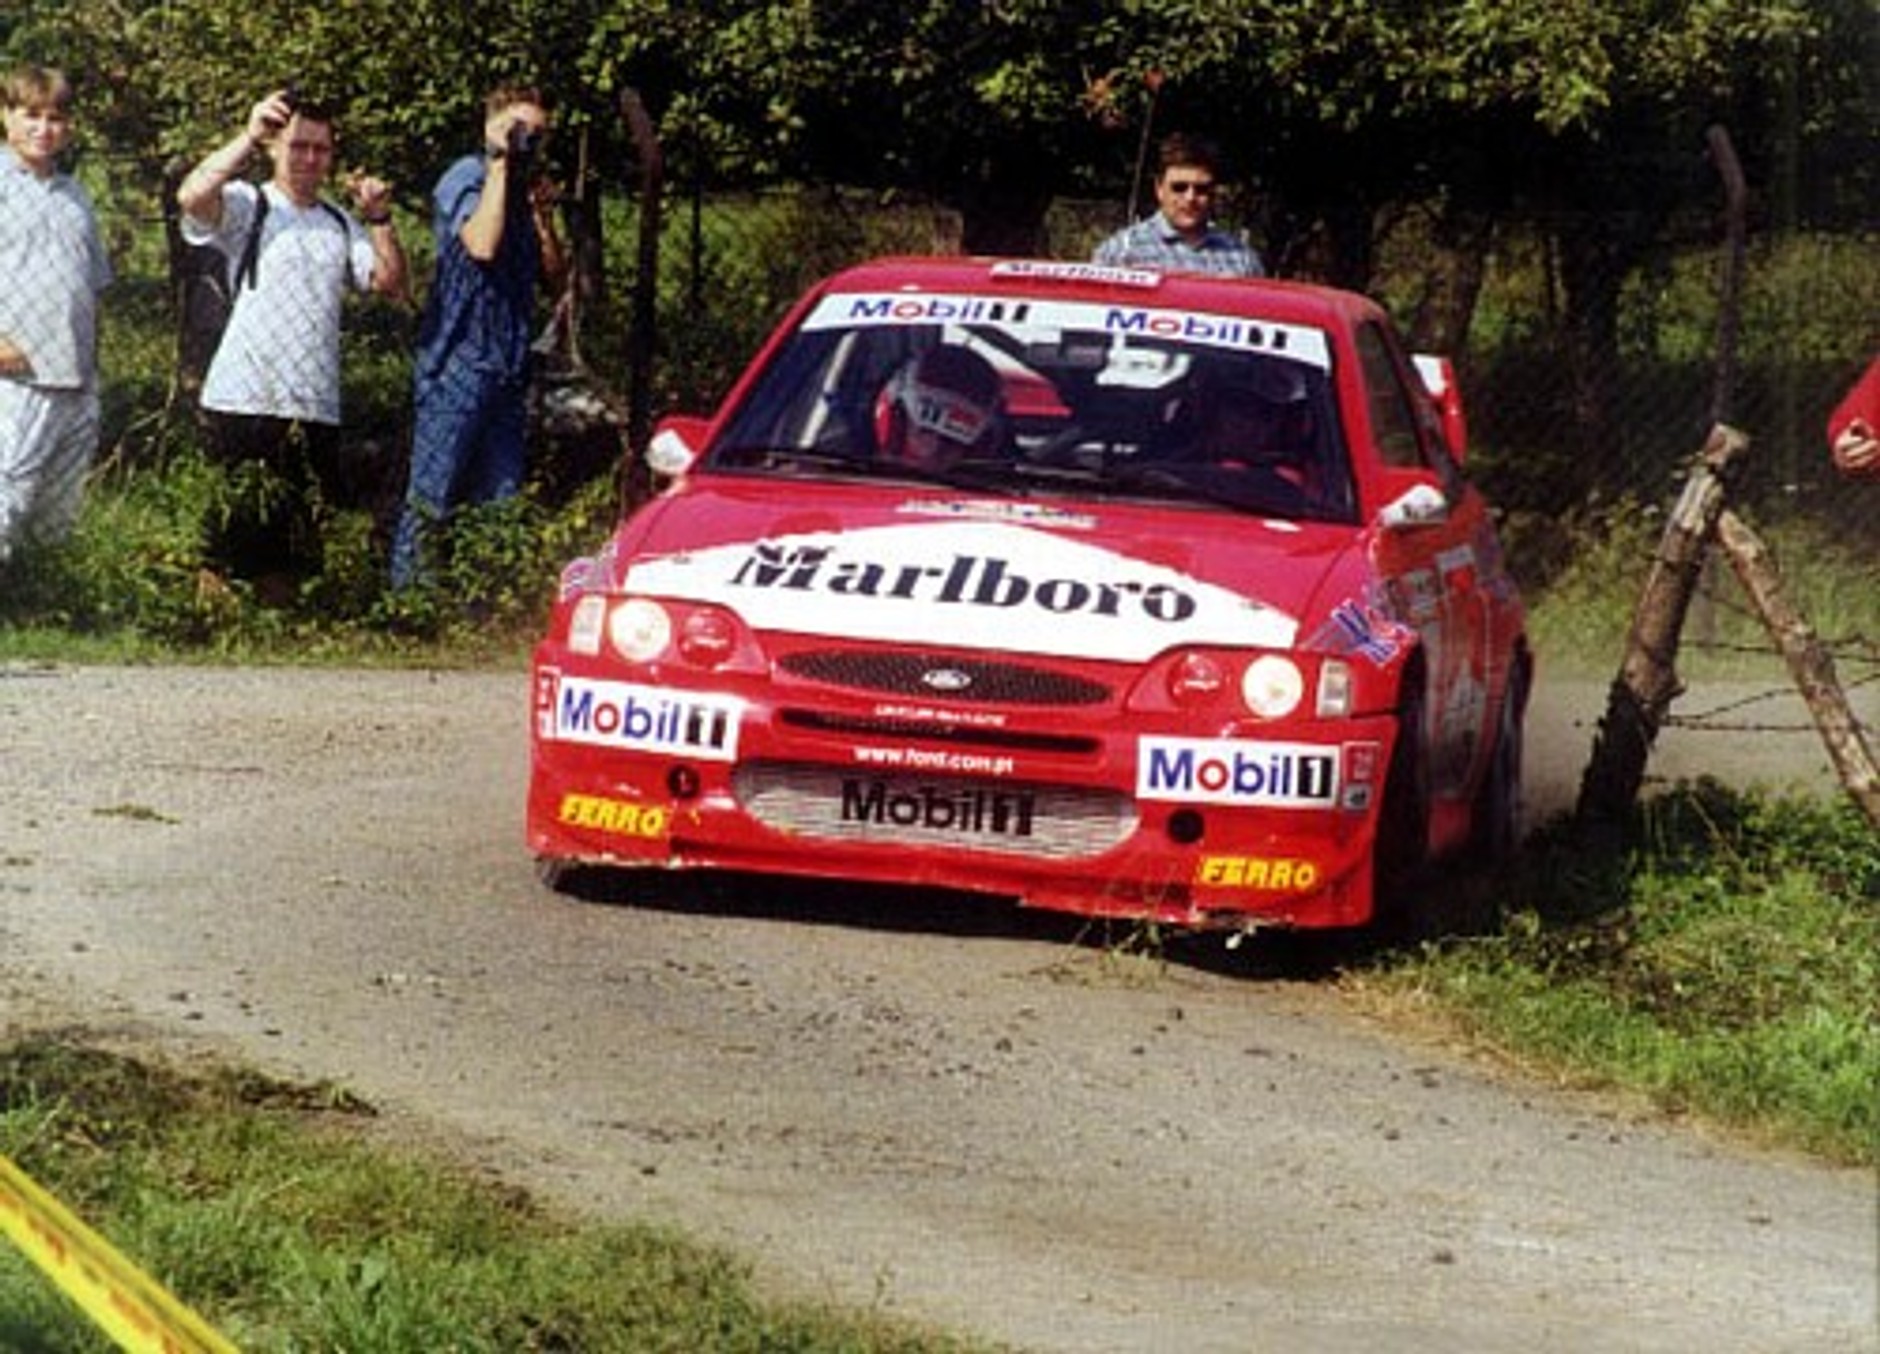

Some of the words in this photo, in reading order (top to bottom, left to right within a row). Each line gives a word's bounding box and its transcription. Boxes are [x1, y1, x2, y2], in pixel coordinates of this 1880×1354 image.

[729, 545, 1197, 622] Marlboro
[560, 793, 664, 838] FERRO
[1200, 856, 1316, 889] FERRO
